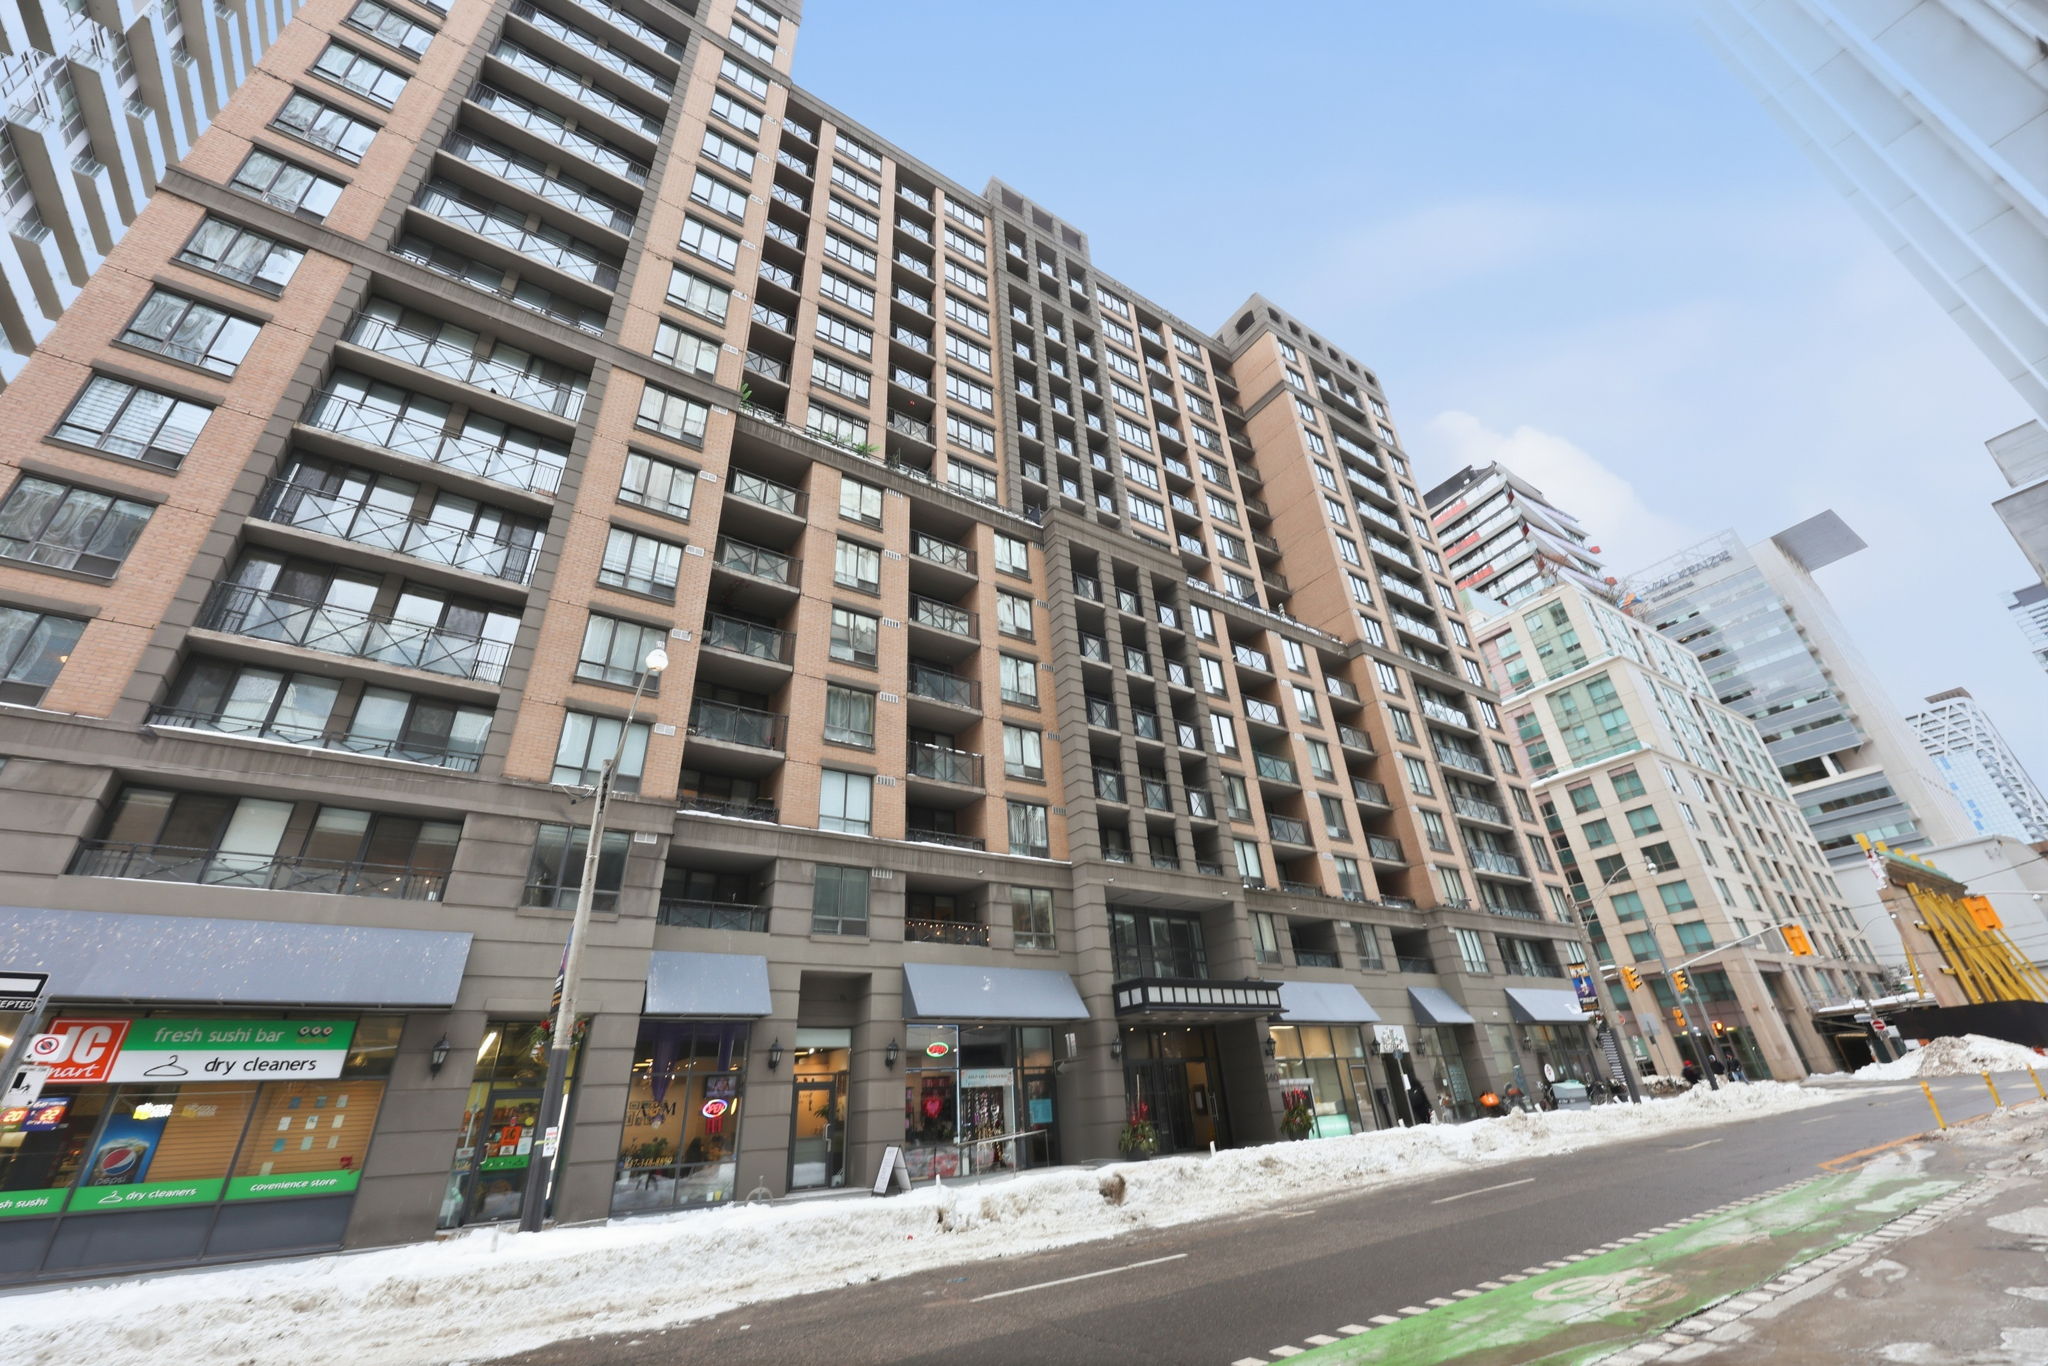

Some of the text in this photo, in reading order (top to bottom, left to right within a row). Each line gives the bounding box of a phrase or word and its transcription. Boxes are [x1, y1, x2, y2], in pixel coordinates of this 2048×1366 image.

[0, 1000, 34, 1009] EPTED
[154, 1028, 285, 1043] fresh sushi bar
[204, 1057, 317, 1076] dry cleaners
[94, 1175, 127, 1186] pepsi
[310, 1178, 338, 1187] store
[125, 1188, 197, 1201] dry cleaners
[15, 1197, 48, 1208] sushi
